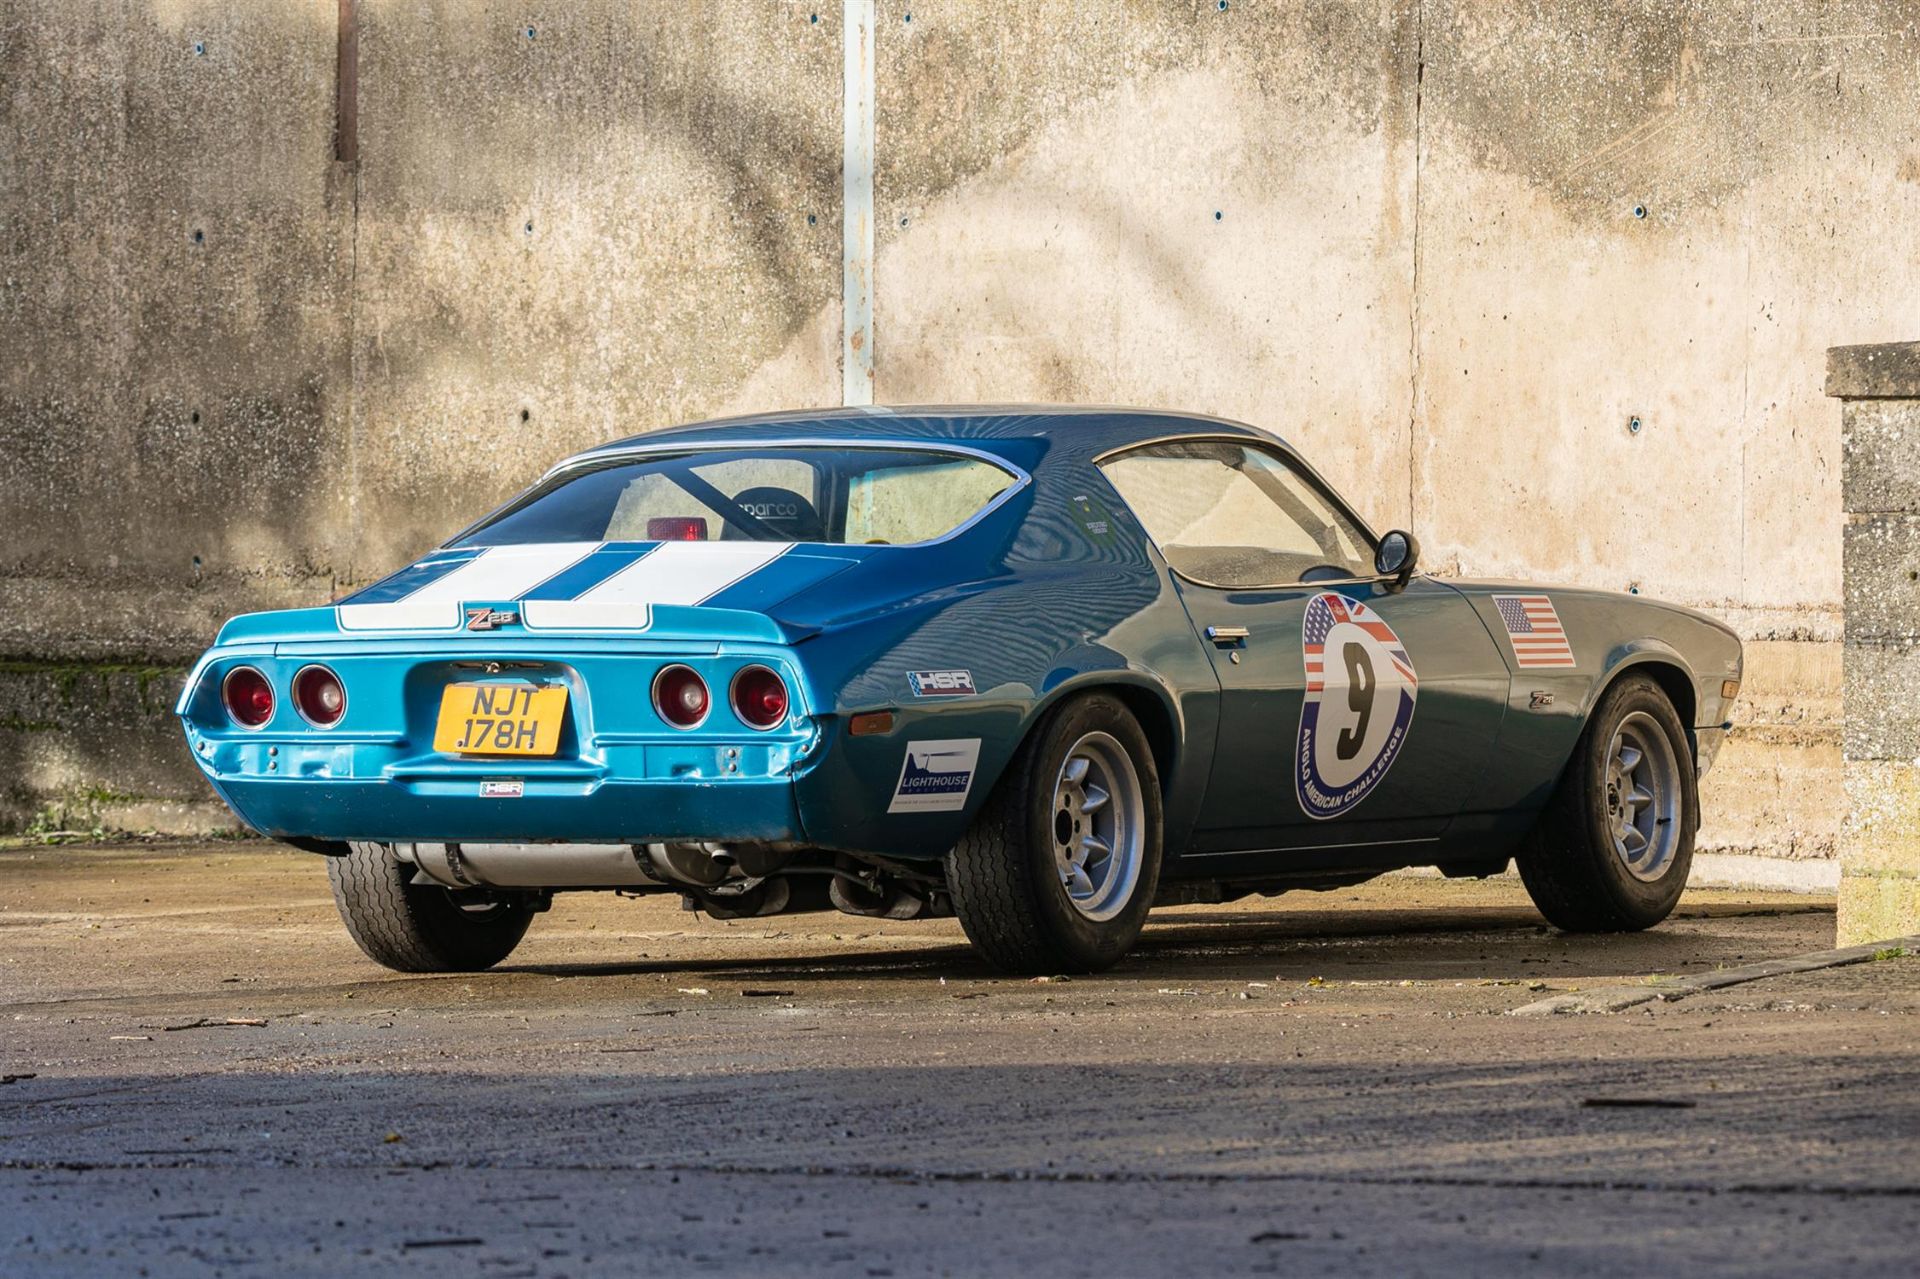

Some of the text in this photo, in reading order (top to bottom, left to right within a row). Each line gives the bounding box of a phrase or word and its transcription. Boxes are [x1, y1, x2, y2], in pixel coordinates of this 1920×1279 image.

[738, 503, 798, 517] parco
[466, 607, 517, 632] Z28
[916, 672, 972, 689] HSR
[472, 687, 539, 716] NJT
[1336, 642, 1376, 760] 9
[1529, 690, 1554, 709] Z28
[463, 719, 538, 750] 178H
[1302, 725, 1403, 809] ANGLO AMERICAN CHALLENGE
[902, 775, 968, 788] LIGHTHOUSE
